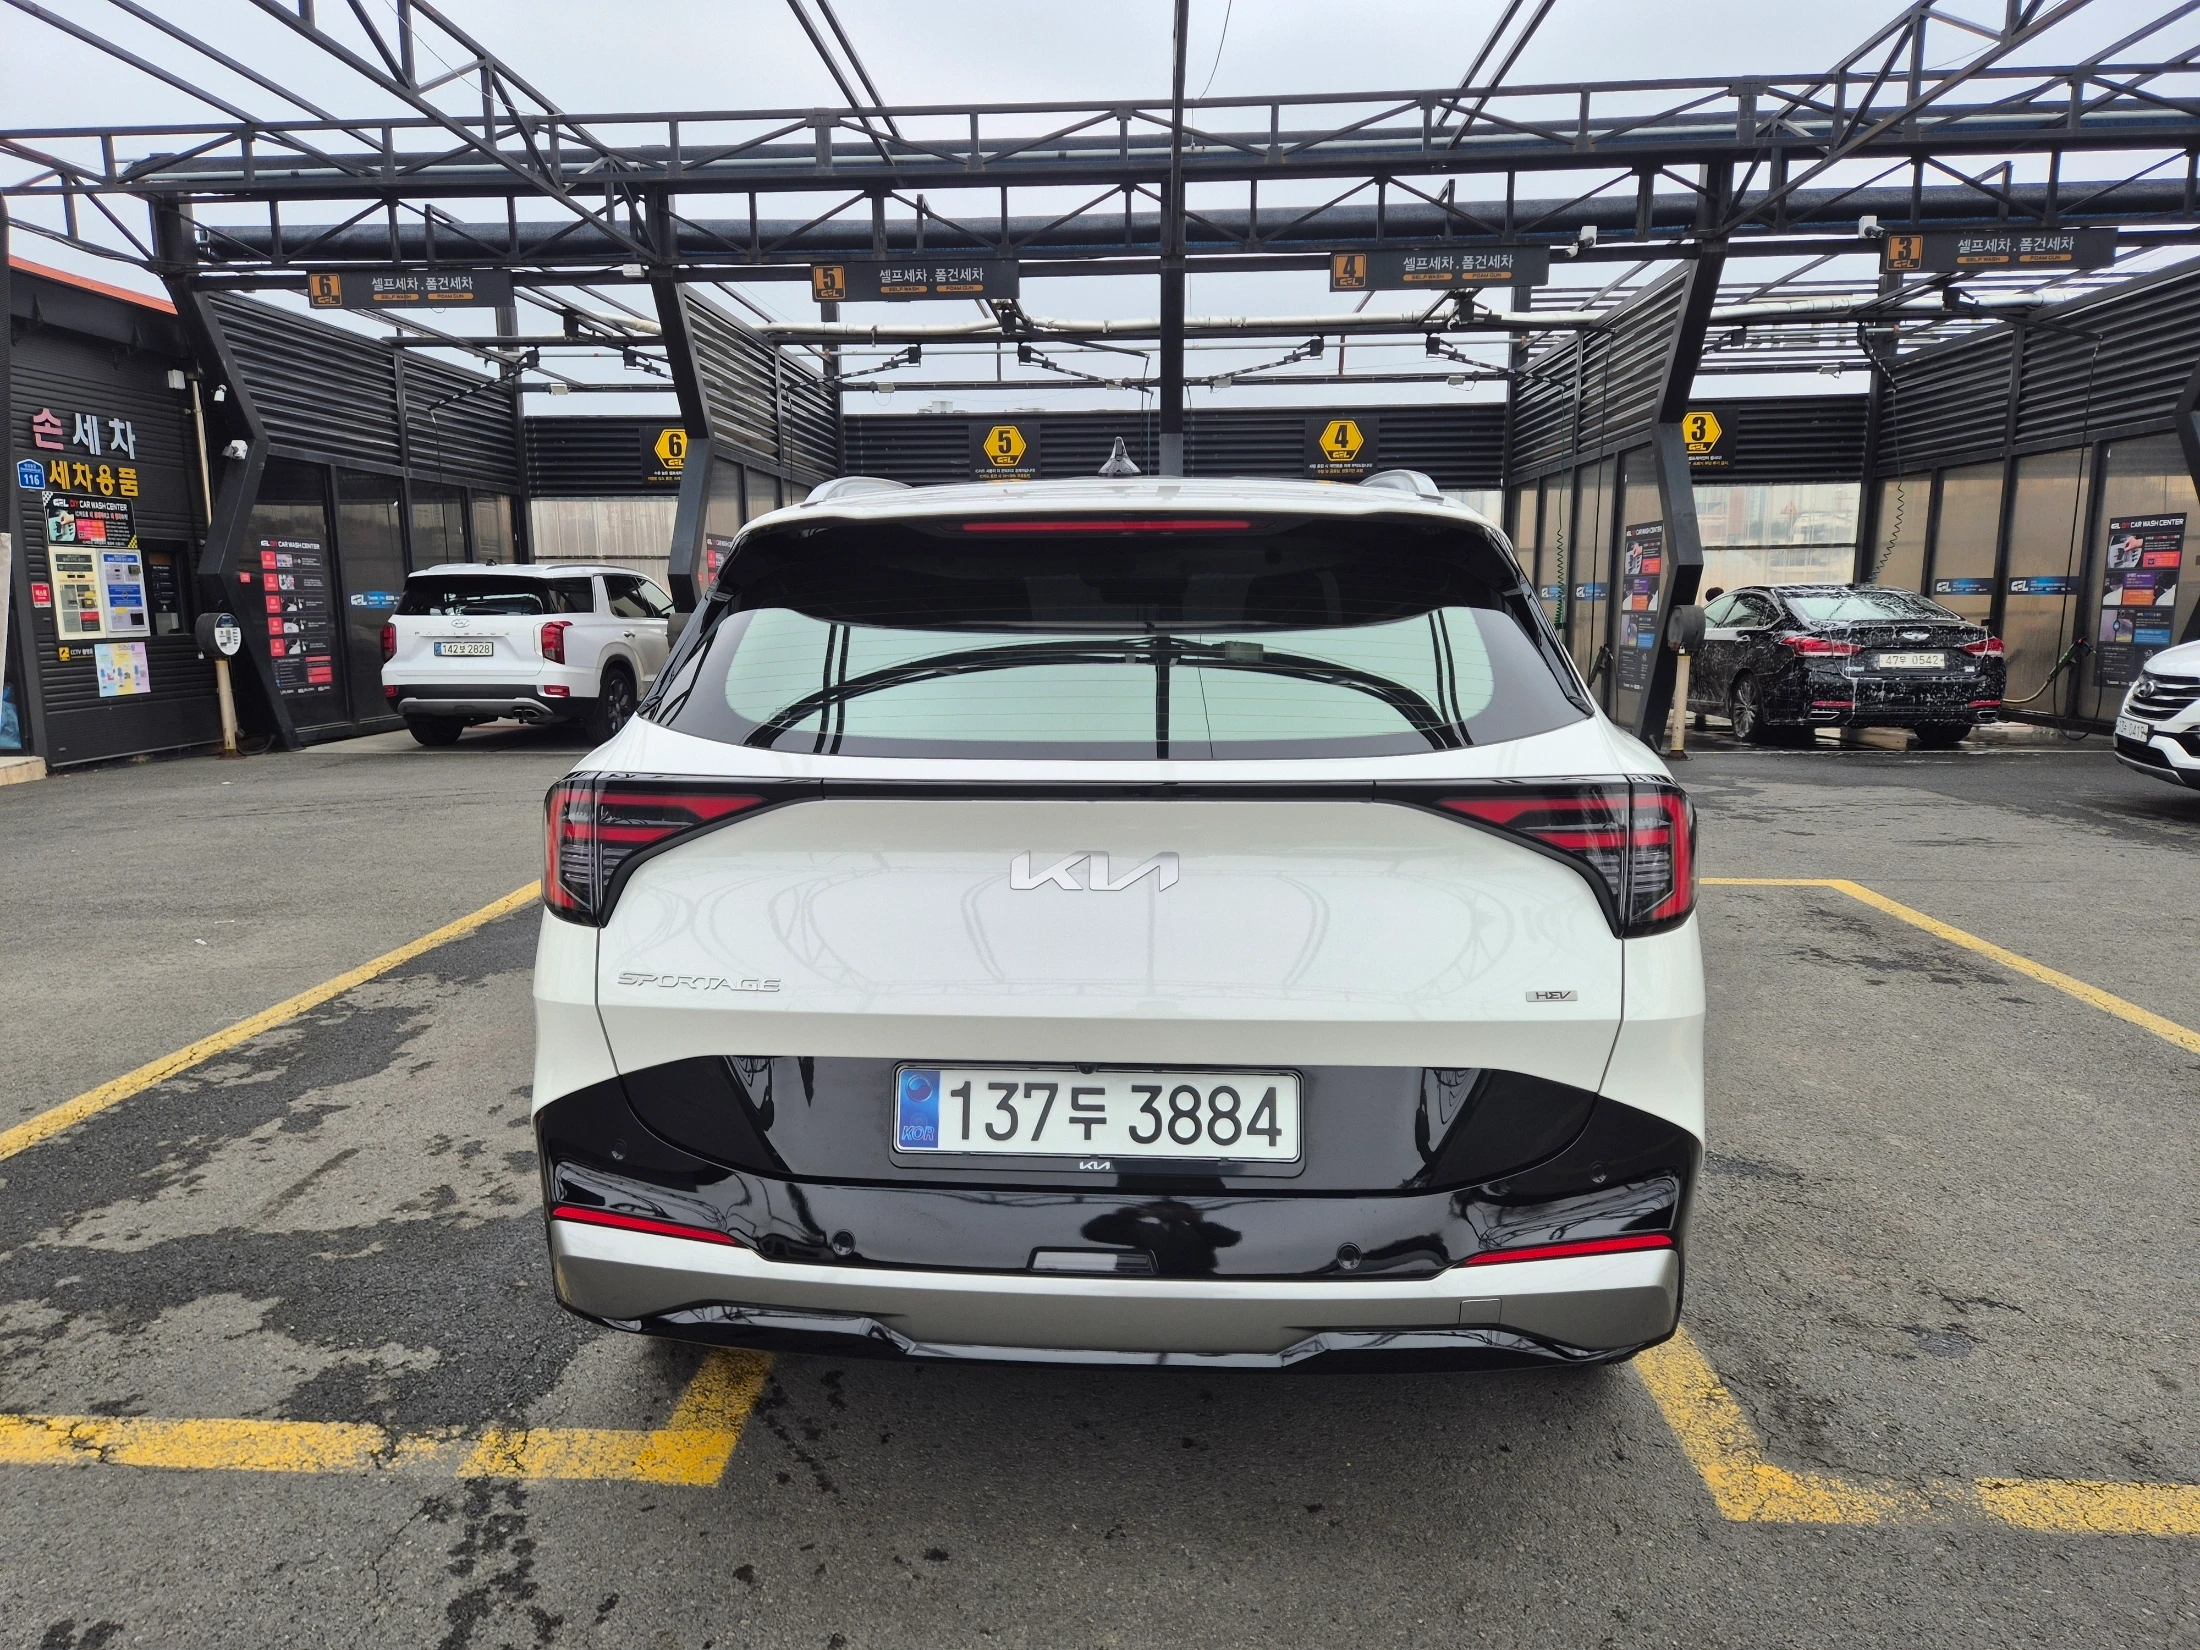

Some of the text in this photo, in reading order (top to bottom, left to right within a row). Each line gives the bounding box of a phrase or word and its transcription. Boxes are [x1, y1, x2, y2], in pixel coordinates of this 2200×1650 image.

[1898, 237, 1912, 260] 3
[2019, 236, 2075, 252] 폼건세차
[1343, 255, 1357, 277] 4
[1461, 254, 1514, 270] 폼건세차
[425, 276, 473, 290] 폼건세차
[823, 268, 836, 290] 5
[934, 267, 984, 282] 폼건세차
[318, 275, 332, 297] 6
[32, 408, 136, 460] 손세차
[1334, 425, 1349, 448] 4
[1691, 416, 1706, 441] 3
[668, 433, 683, 457] 6
[998, 430, 1012, 454] 5
[23, 473, 40, 485] 116
[49, 460, 139, 497] 세차용품
[80, 500, 90, 509] CAR
[91, 501, 106, 510] WASH
[106, 502, 128, 511] CENTER
[2159, 518, 2184, 526] CENTER
[442, 644, 490, 654] 142보 2828
[1912, 655, 1939, 665] 0542
[1010, 850, 1180, 892] KIA
[617, 972, 781, 993] SPORTAGE
[1535, 991, 1572, 1000] HEV
[950, 1080, 1283, 1148] 137두 3884
[901, 1126, 935, 1142] KOR
[1079, 1160, 1110, 1170] KIA
